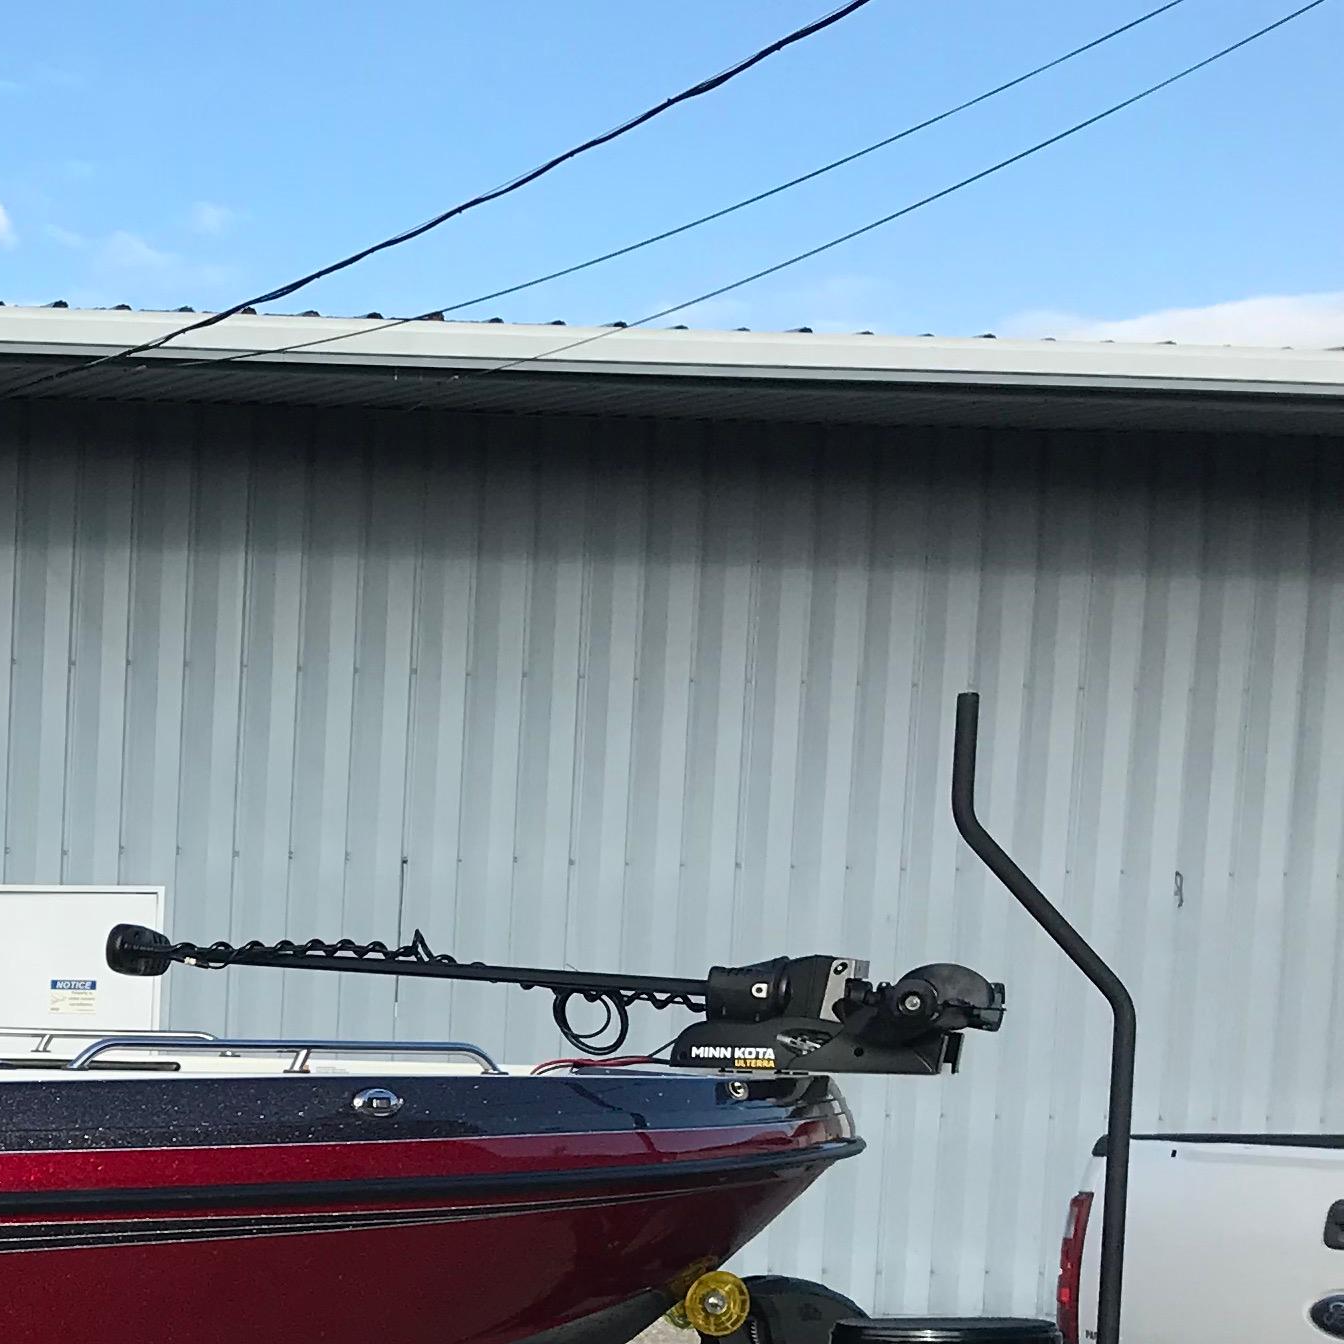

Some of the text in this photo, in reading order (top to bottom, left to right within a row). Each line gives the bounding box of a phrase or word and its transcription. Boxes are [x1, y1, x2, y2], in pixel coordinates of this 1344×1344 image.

[55, 981, 92, 989] NOTICE
[691, 1046, 775, 1060] MINN KOTA
[734, 1060, 775, 1068] ULTERRA
